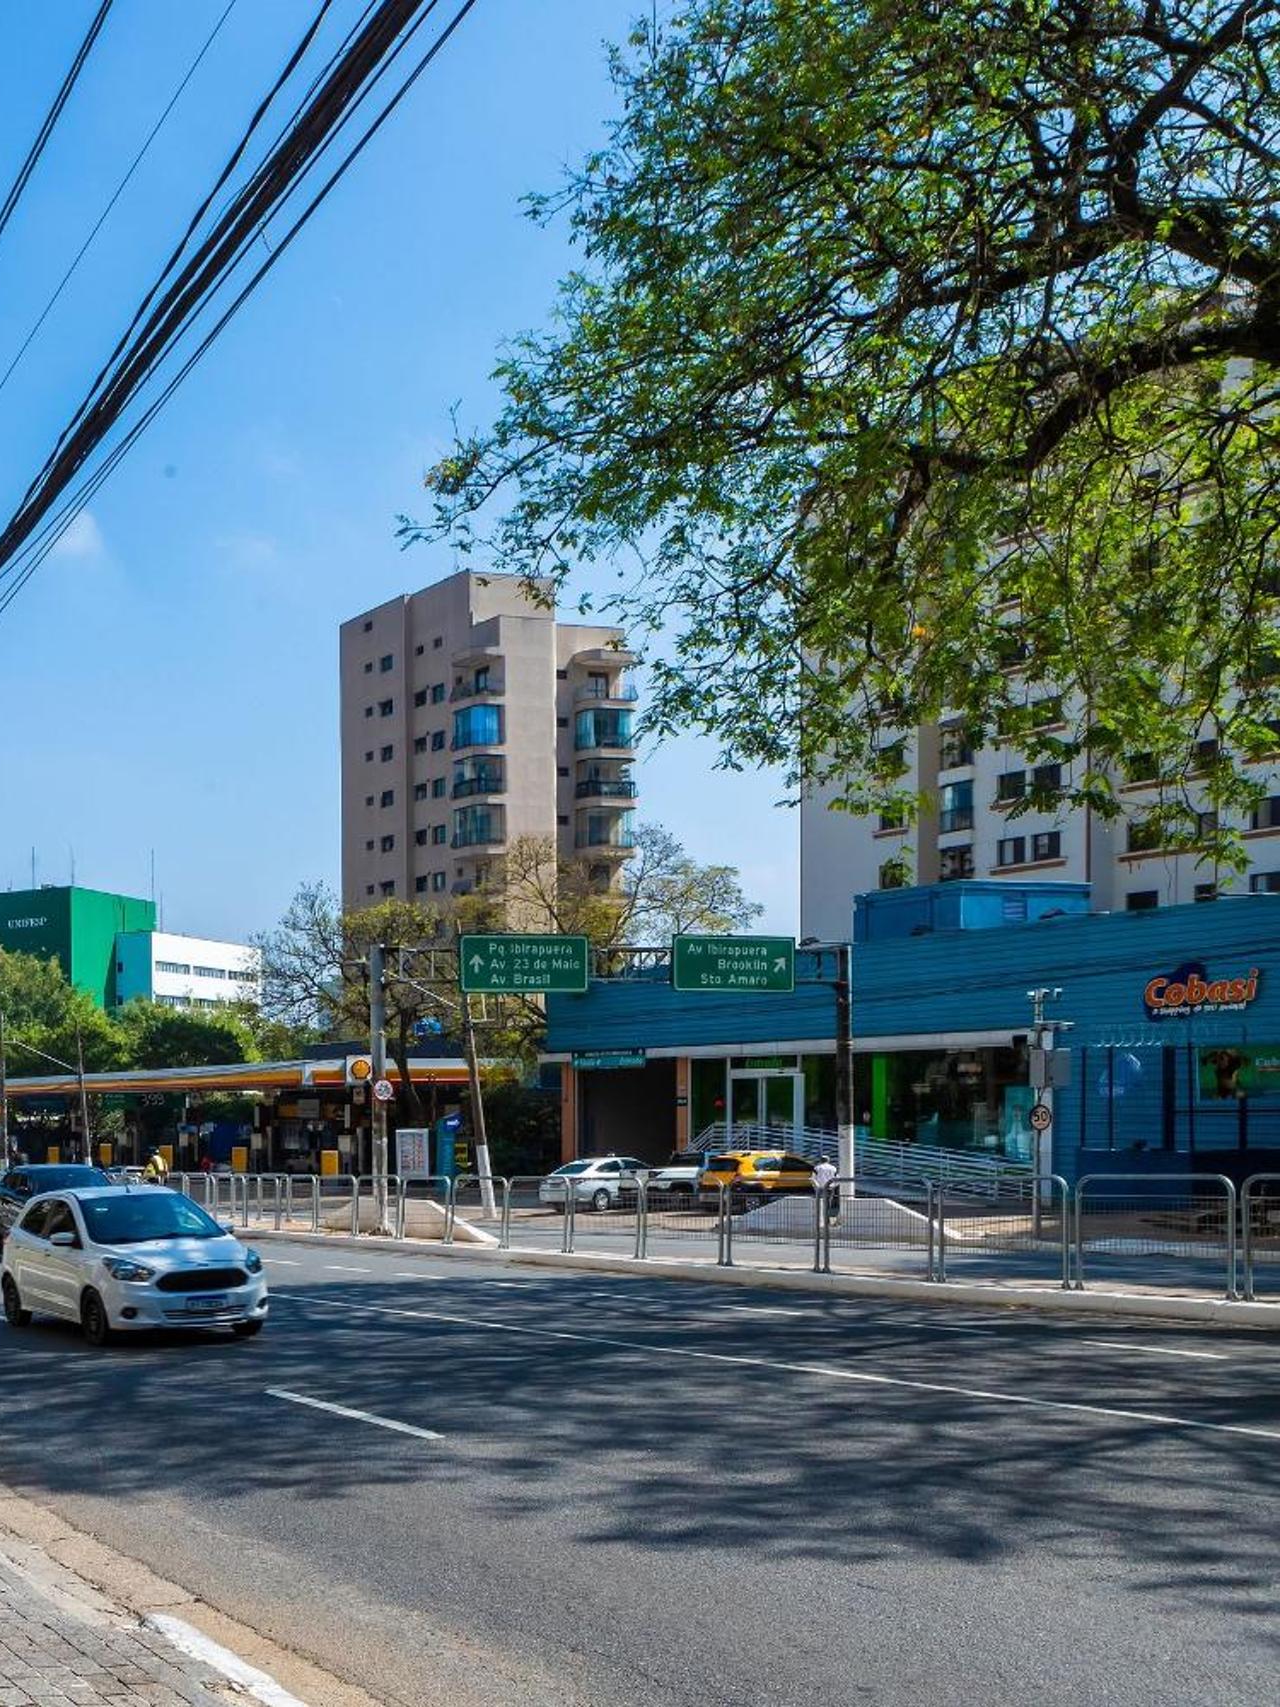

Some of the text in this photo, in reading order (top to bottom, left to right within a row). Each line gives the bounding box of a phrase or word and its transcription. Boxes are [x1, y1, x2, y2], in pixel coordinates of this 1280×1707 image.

[488, 943, 573, 957] Pq Ibirapuera
[686, 943, 768, 957] Av Ibirapuera
[490, 959, 580, 969] Av 23 de Maio
[718, 959, 768, 971] Brooklin
[490, 974, 551, 985] Av Brasil
[700, 973, 768, 985] Sto Amaro
[1145, 968, 1259, 1008] Cobasi
[1033, 1110, 1048, 1122] 50
